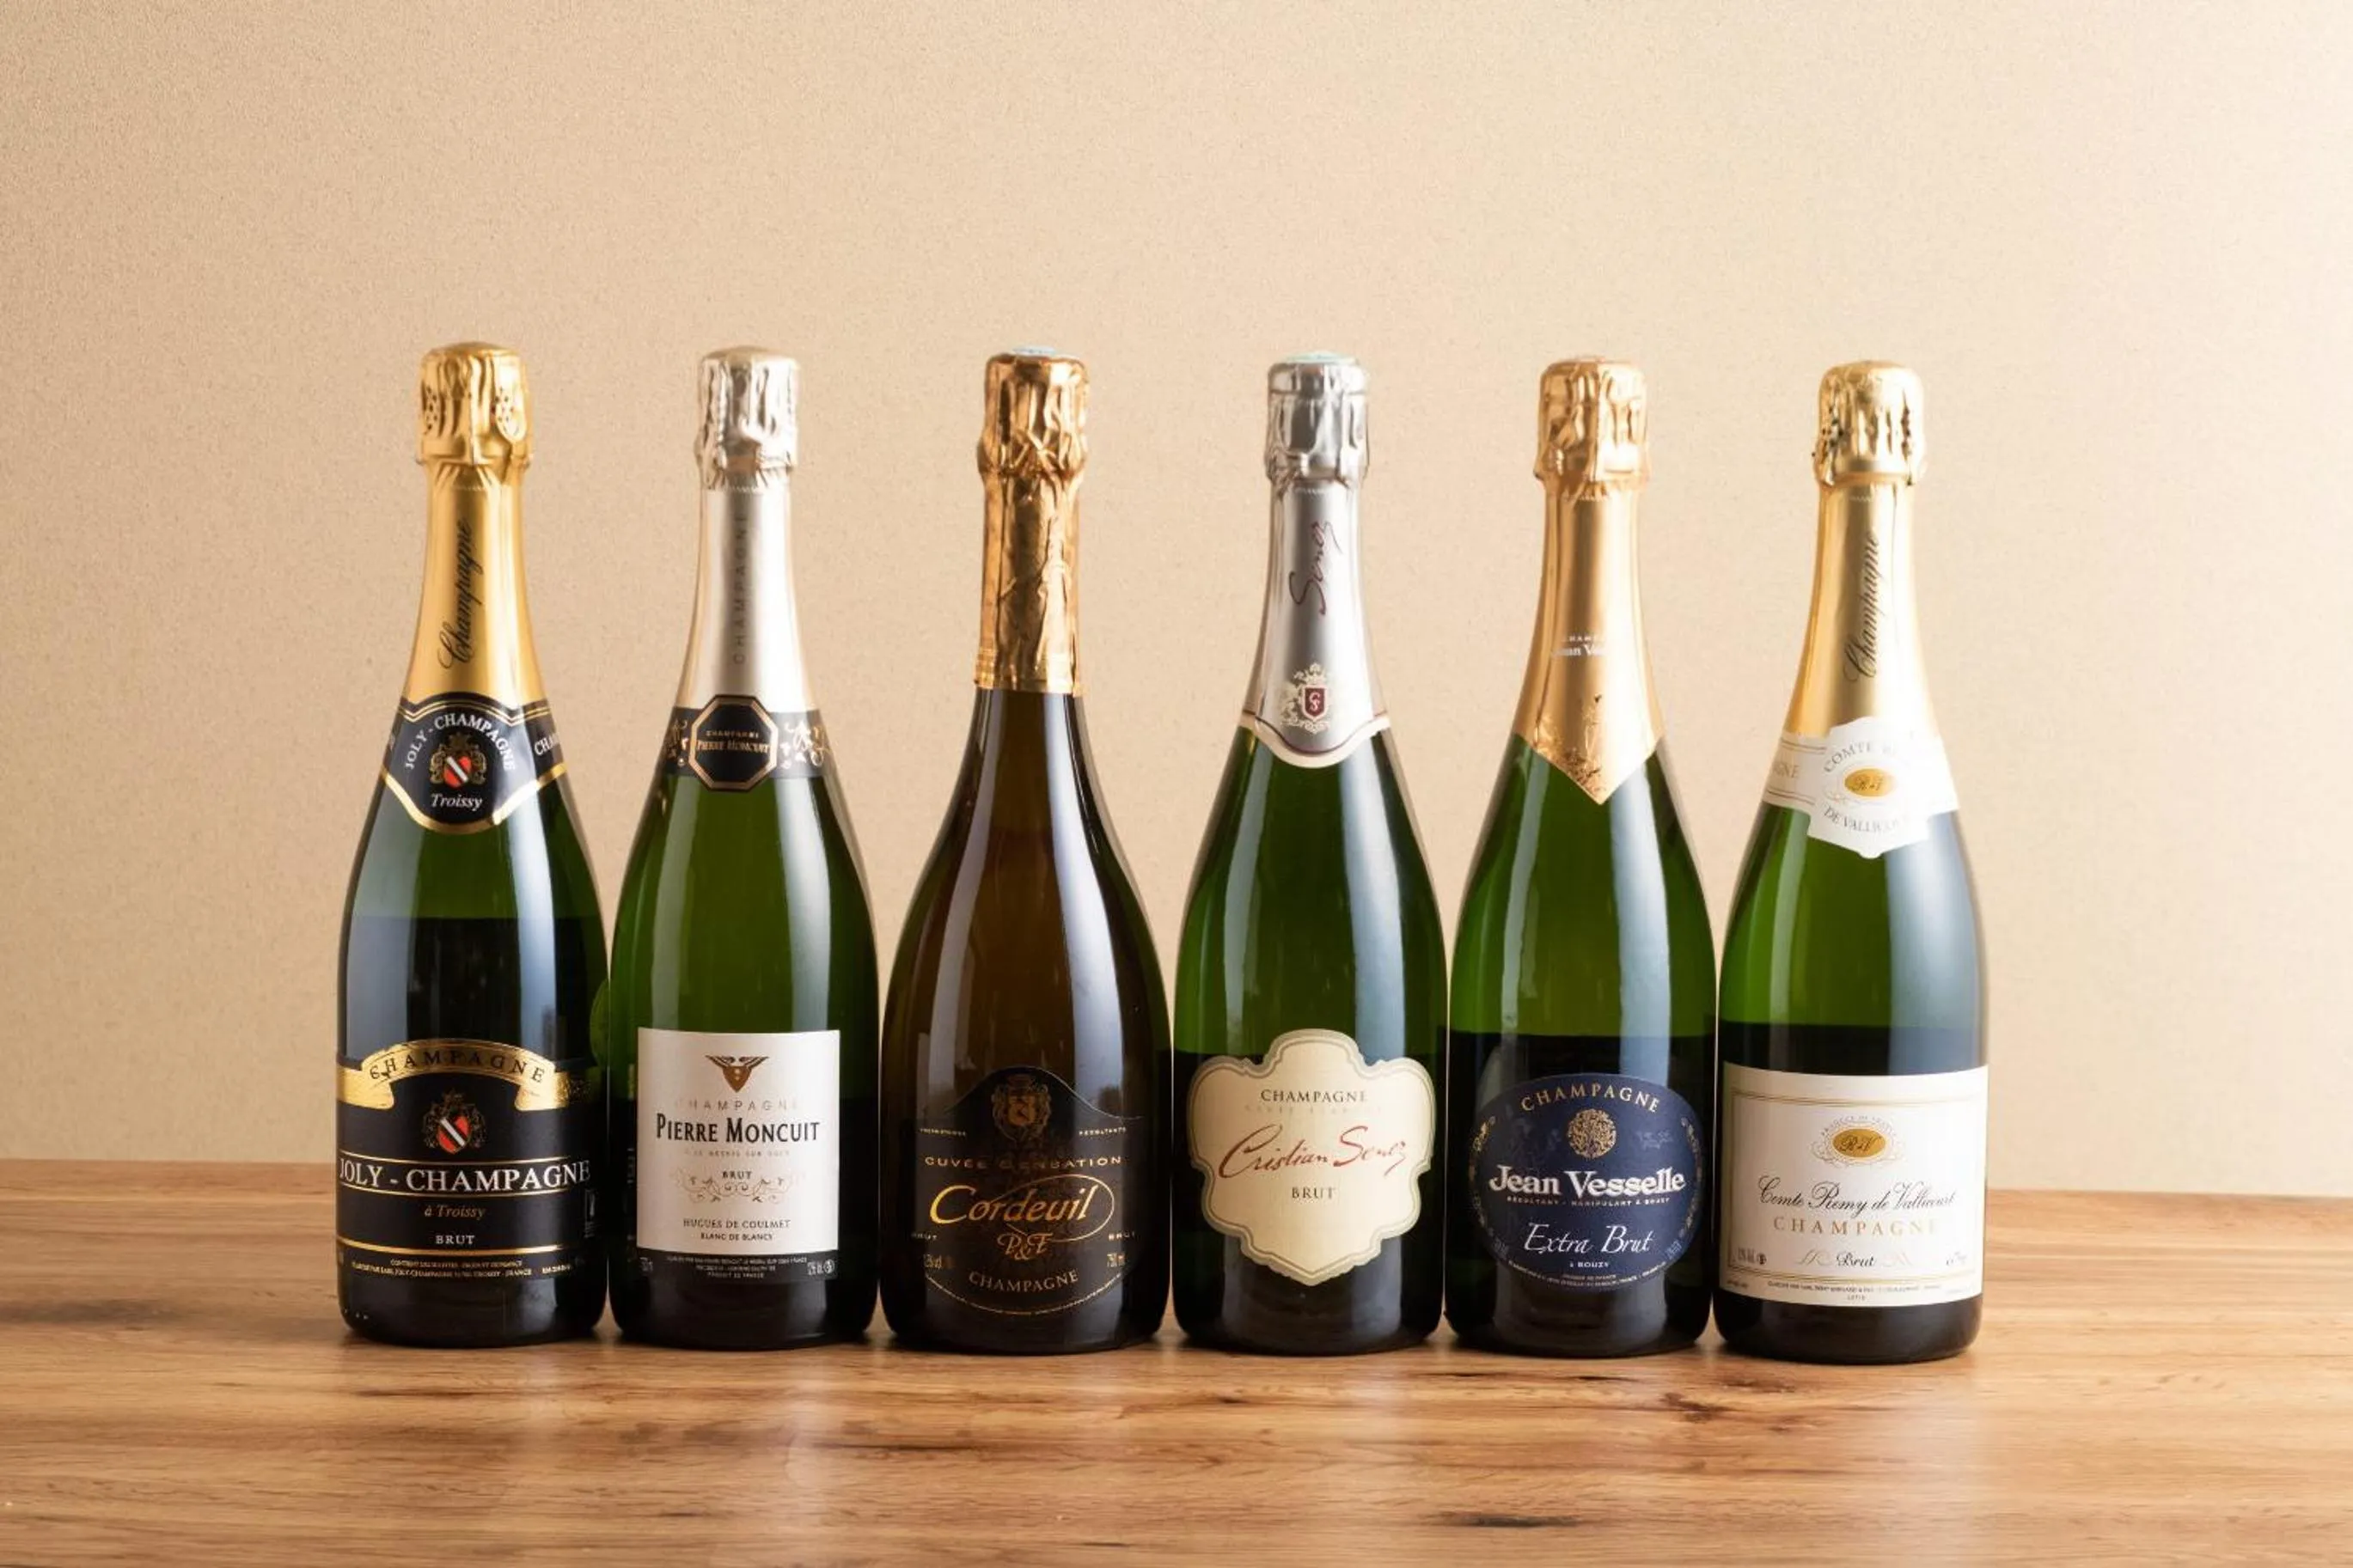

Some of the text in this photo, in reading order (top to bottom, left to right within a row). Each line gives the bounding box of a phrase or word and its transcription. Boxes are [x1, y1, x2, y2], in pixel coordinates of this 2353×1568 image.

[437, 516, 485, 671] Champagne
[1843, 530, 1883, 684] Champagne
[405, 728, 429, 771] JOLY
[434, 712, 517, 772] CHAMPAGNE
[431, 793, 484, 812] Troissy
[370, 1048, 546, 1083] CHAMPAGNE
[1259, 1089, 1368, 1103] CHAMPAGNE
[1520, 1083, 1660, 1113] CHAMPAGNE
[656, 1113, 821, 1144] PIERRE MONCUIT
[339, 1158, 383, 1188] JOLY
[406, 1159, 591, 1193] CHAMPAGNE
[722, 1170, 753, 1181] BRUT
[1488, 1164, 1687, 1198] Jean Vesselle
[1292, 1187, 1336, 1200] BRUT
[1871, 1191, 1891, 1211] de
[436, 1205, 488, 1222] Troissy
[929, 1184, 1099, 1225] Cordeuil
[726, 1219, 739, 1229] DE
[1772, 1216, 1940, 1236] CHAMPAGNE
[435, 1234, 475, 1246] BRUT
[700, 1231, 726, 1242] BLANC
[729, 1232, 740, 1242] DE
[1522, 1222, 1594, 1254] Extra
[1601, 1223, 1655, 1254] Brut
[1836, 1250, 1877, 1267] Brut
[969, 1270, 1079, 1293] CHAMPAGNE
